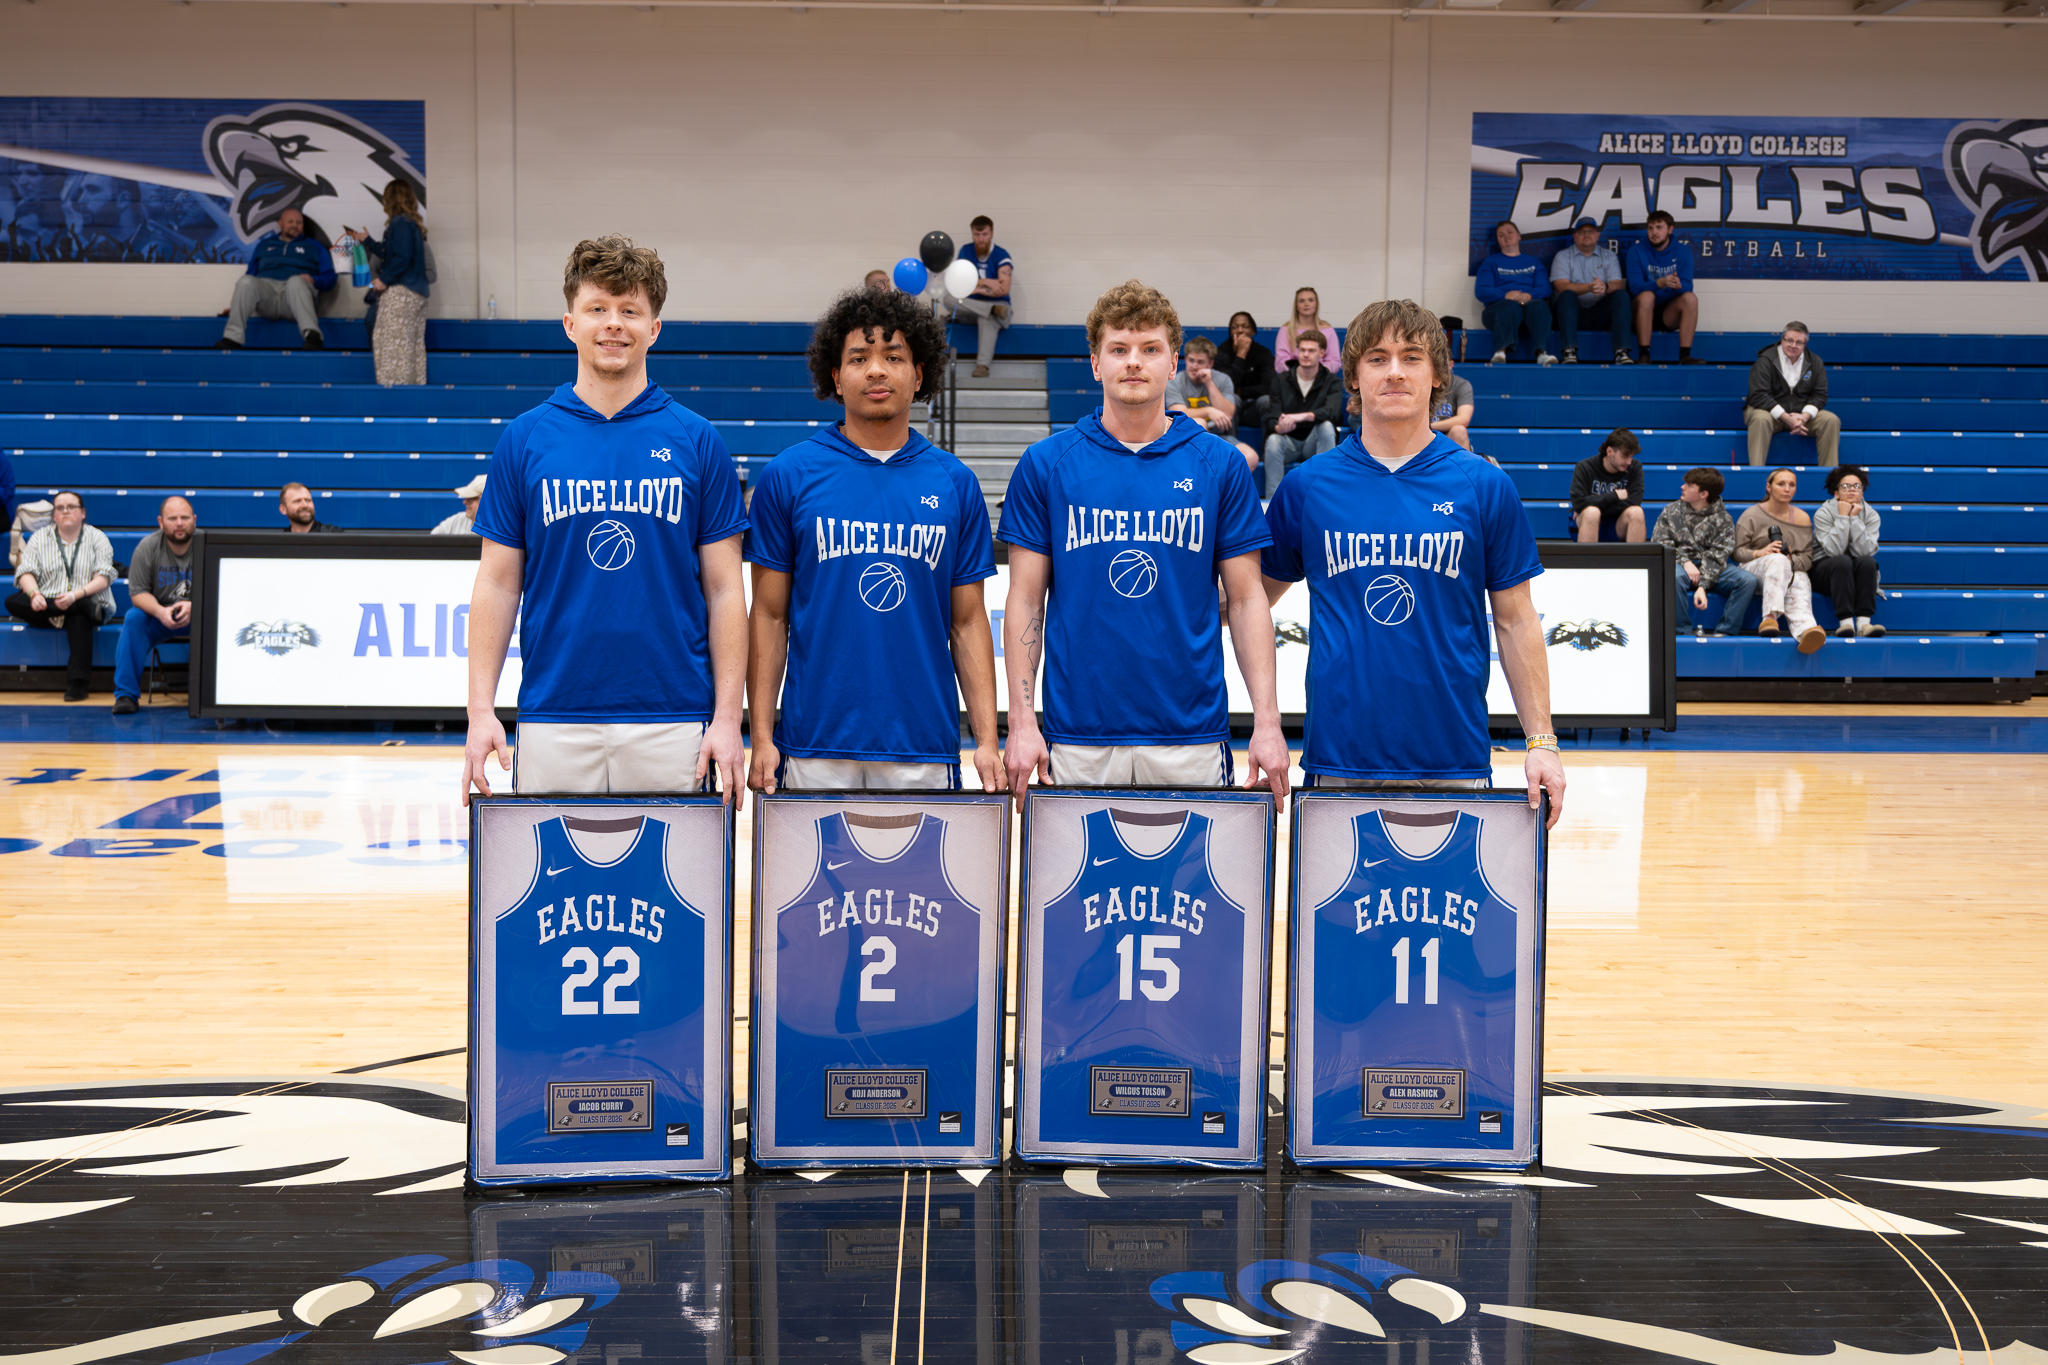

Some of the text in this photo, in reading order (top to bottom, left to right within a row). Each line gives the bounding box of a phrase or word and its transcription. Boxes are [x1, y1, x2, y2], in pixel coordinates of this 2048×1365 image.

[1599, 133, 1847, 156] ALICE LLOYD COLLEGE
[1510, 162, 1937, 241] EAGLES
[1608, 239, 1827, 258] BETBALL
[542, 477, 683, 527] ALICE LLOYD
[1065, 504, 1204, 553] ALICE LLOYD
[816, 516, 946, 571] ALICE LLOYD
[1324, 530, 1464, 579] ALICE LLOYD
[254, 635, 301, 649] EAGLES
[537, 894, 665, 945] EAGLES
[817, 888, 942, 937] EAGLES
[1083, 885, 1207, 935] EAGLES
[1353, 886, 1478, 936] EAGLES
[860, 936, 897, 1002] 2
[1116, 934, 1181, 1002] 15
[1391, 937, 1439, 1005] 11
[562, 946, 640, 1015] 22
[833, 1075, 918, 1085] ALICE LLOYD COLLEGE
[1097, 1072, 1182, 1084] ALICE LLOYD COLLEGE
[1370, 1074, 1456, 1085] ALICE LLOYD COLLEGE
[556, 1087, 644, 1098] ALICE LLOYD COLLEGE
[852, 1089, 901, 1098] KOJI ANDERSON
[1115, 1086, 1166, 1096] WILGUS TOLSON
[1389, 1088, 1438, 1098] ALEX RASNICK
[578, 1101, 624, 1111] JACOB CURRY
[855, 1102, 897, 1110] CLASS OF 2026
[1119, 1099, 1161, 1108] CLASS OF 2026
[1392, 1101, 1435, 1110] CLASS OF 2026
[579, 1115, 623, 1124] CLASS OF 2026
